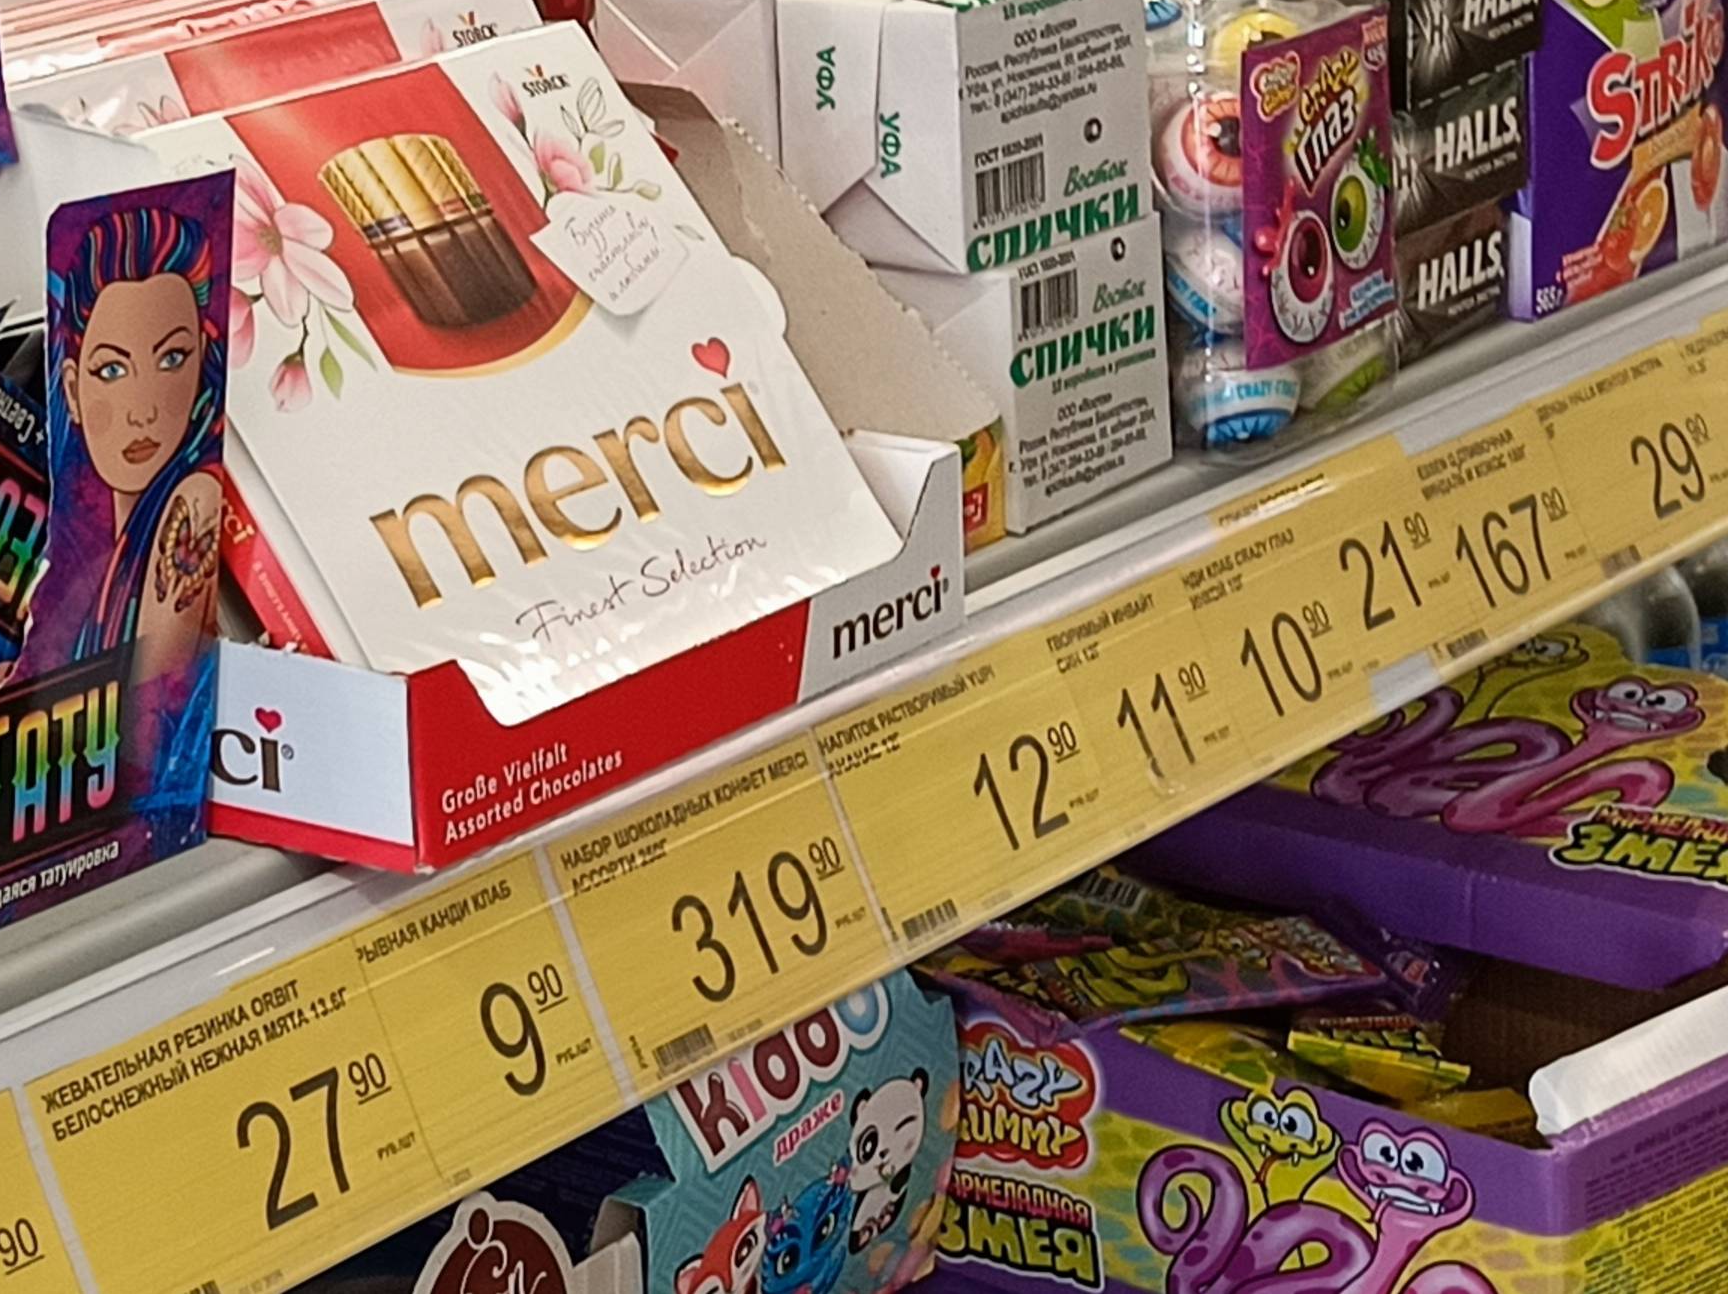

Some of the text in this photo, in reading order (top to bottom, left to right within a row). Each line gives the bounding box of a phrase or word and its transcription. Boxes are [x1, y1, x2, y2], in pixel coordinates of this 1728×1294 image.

[1064, 160, 1128, 197] Восток
[1435, 96, 1520, 173] HALLS
[966, 184, 1142, 274] СПИЧКИ
[1418, 230, 1504, 311] HALLS
[1093, 279, 1145, 312] Восток
[1010, 305, 1155, 388] СПИЧКИ
[369, 362, 790, 609] merci
[1629, 421, 1706, 519] 29
[515, 532, 768, 643] Finest Selection
[1338, 520, 1423, 632] 21
[1454, 494, 1554, 610] 167
[832, 568, 947, 659] merci
[1240, 602, 1330, 718] 10 90
[818, 721, 875, 755] НАПИТОК
[1117, 662, 1207, 780] 11 90
[441, 742, 570, 814] Große Vielfalt
[444, 747, 624, 846] Assorted Chocolates
[561, 749, 809, 871] НАБОР ШОКОЛАДНЫХ КОНФЕТ MERCI
[972, 721, 1078, 852] 12 90
[39, 840, 119, 890] татуировка
[420, 878, 513, 939] КАНДИ КЛАБ
[671, 836, 842, 1003] 319 90
[44, 979, 300, 1112] ЖЕВАТЕЛЬНАЯ РЕЗИНКА ORBIT
[51, 1008, 310, 1143] БЕЛОСНЕЖНЫЙ НЕЖНАЯ МЯТА
[480, 964, 564, 1097] 9 90
[235, 1053, 389, 1231] 27 90
[773, 1091, 844, 1165] драже
